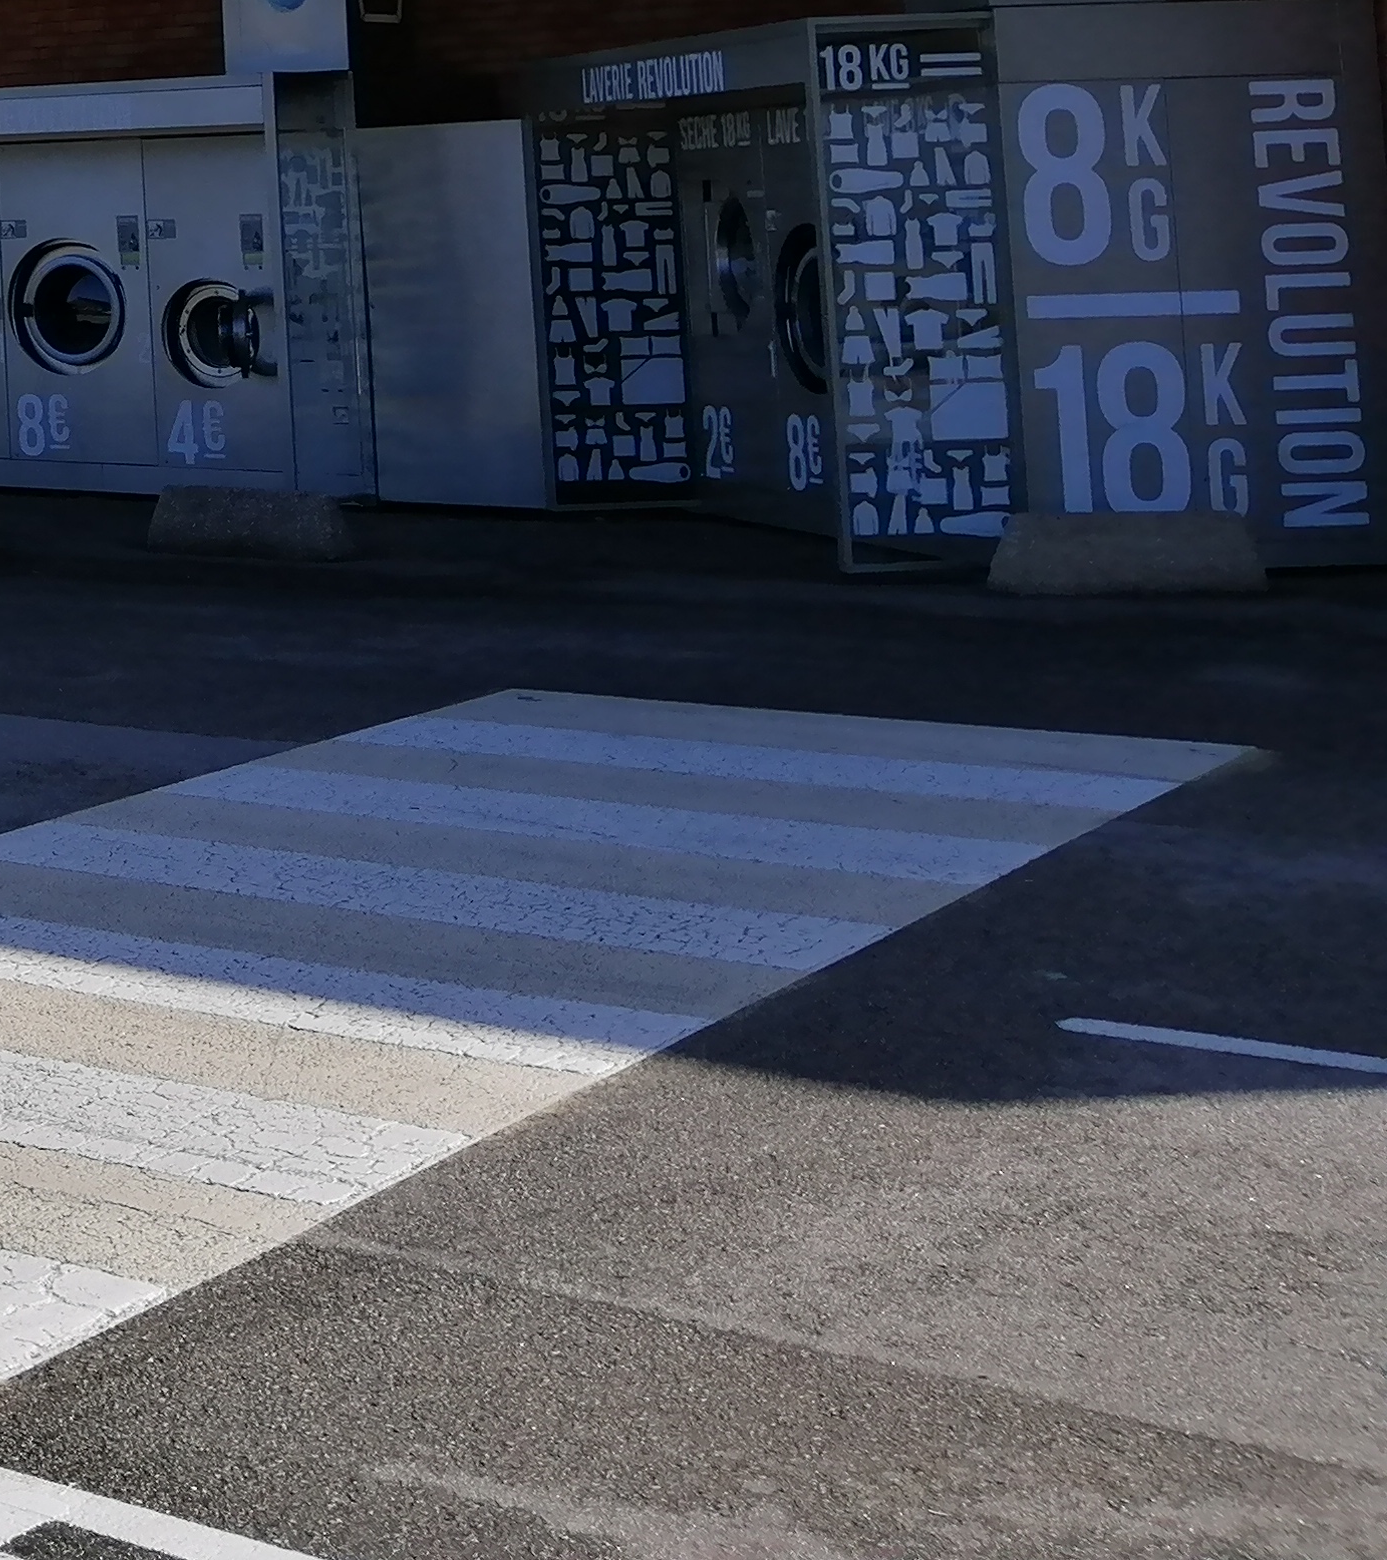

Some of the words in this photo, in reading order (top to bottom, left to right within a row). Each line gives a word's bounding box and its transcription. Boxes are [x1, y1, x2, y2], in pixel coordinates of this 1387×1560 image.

[581, 62, 634, 104] LAVERIE
[636, 49, 725, 101] REVOLUTION
[819, 43, 864, 92] 18
[869, 43, 910, 81] KG
[767, 107, 802, 146] LAVE
[1017, 82, 1113, 266] 8
[1247, 77, 1371, 529] REVOLUTION
[16, 392, 72, 457] 8€
[167, 399, 227, 465] 4€
[702, 404, 736, 480] 2€
[786, 412, 824, 492] 8€
[1034, 340, 1193, 514] 18
